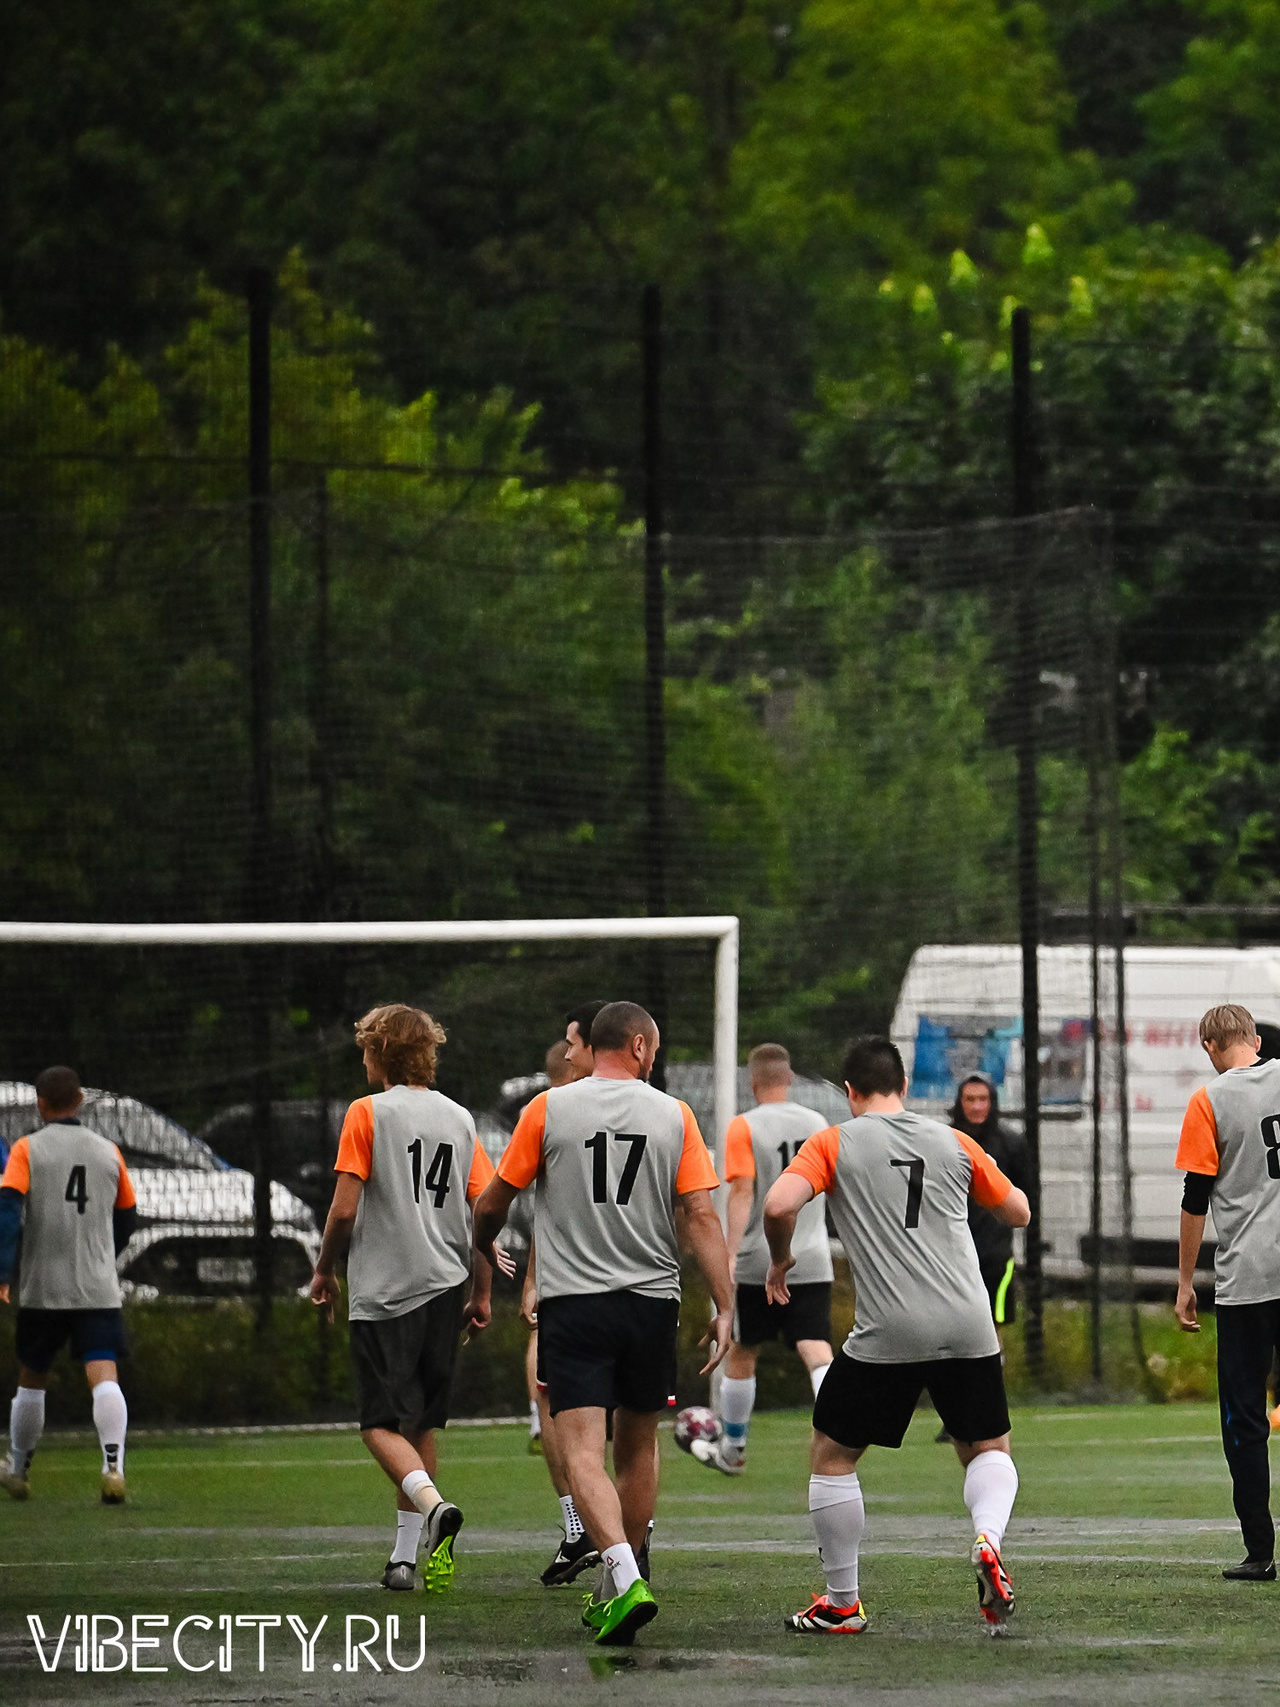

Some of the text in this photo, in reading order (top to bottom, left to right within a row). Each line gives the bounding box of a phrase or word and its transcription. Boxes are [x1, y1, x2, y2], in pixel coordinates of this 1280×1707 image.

[65, 1164, 89, 1215] 4
[407, 1137, 454, 1209] 14
[583, 1131, 647, 1206] 17
[890, 1158, 925, 1229] 7
